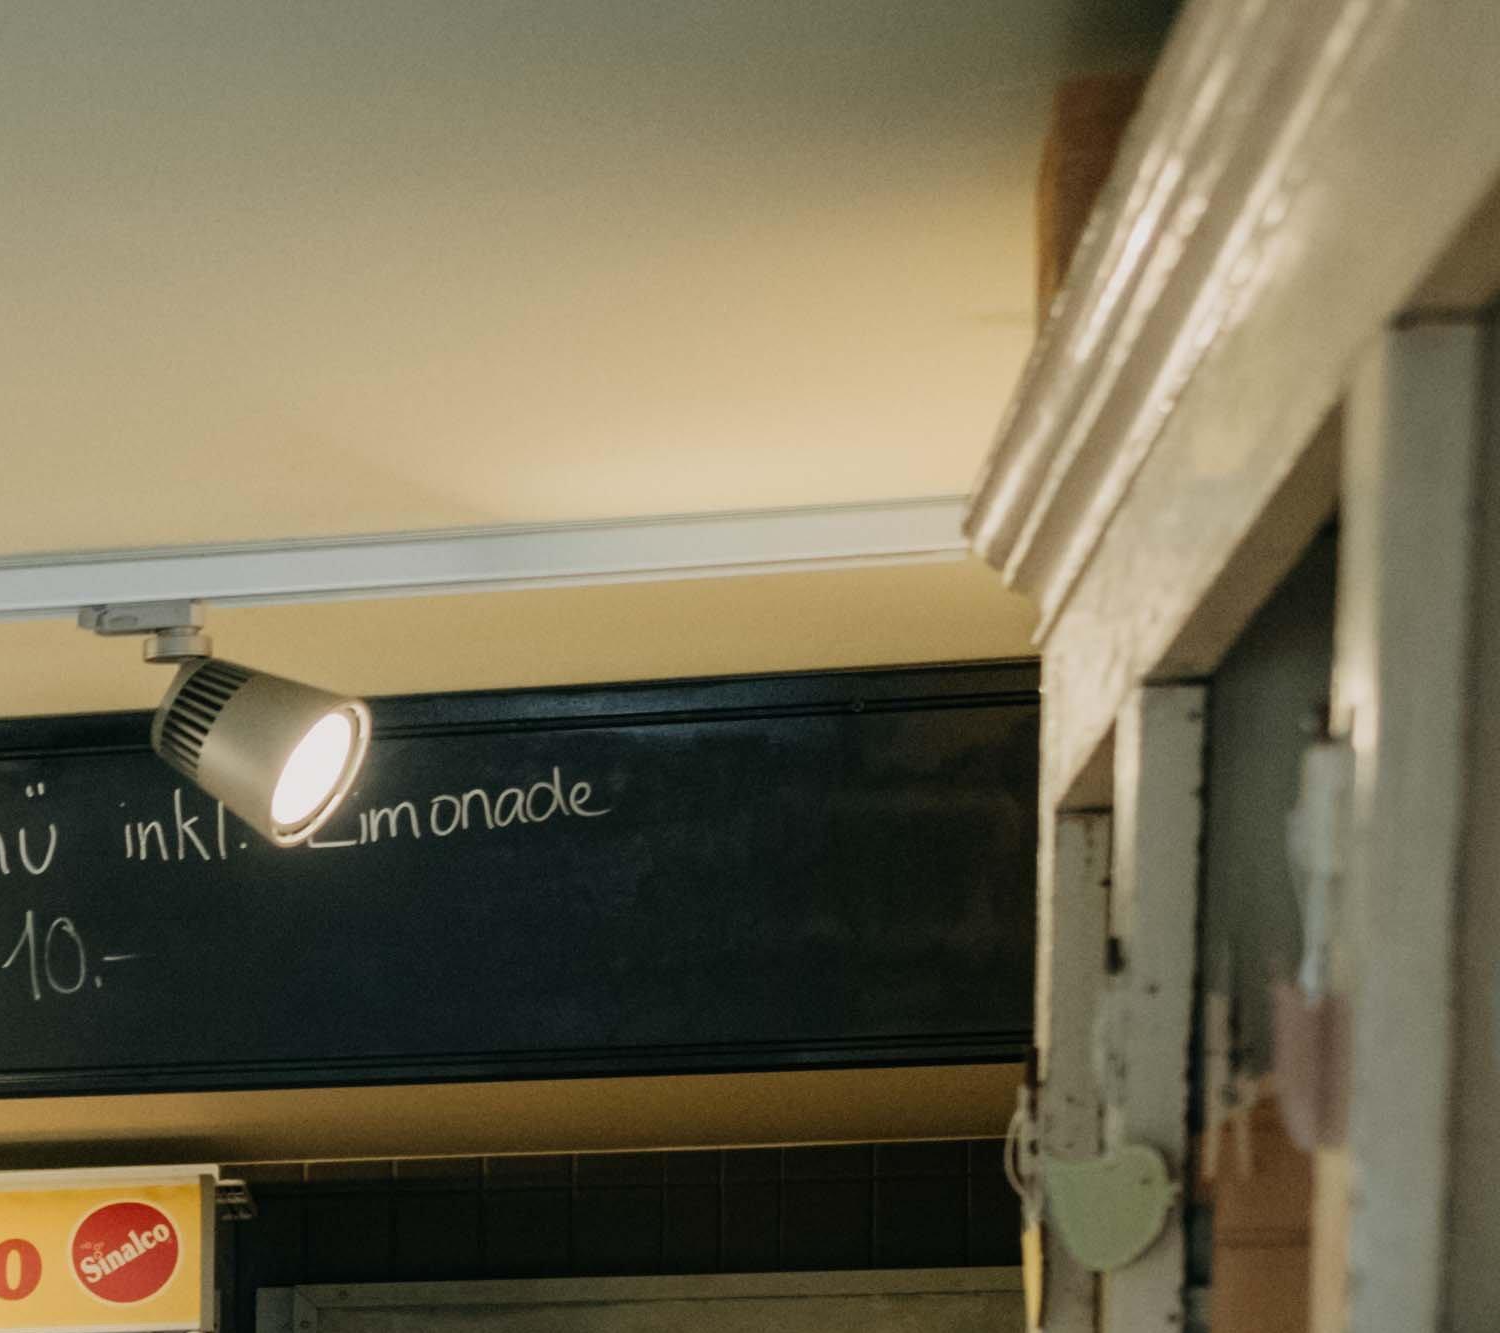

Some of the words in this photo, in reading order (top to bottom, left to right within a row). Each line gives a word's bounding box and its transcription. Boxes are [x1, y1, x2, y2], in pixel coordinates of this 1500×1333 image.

[121, 788, 247, 861] inkl.
[2, 910, 143, 999] 10.-
[80, 1224, 170, 1284] Sinalco
